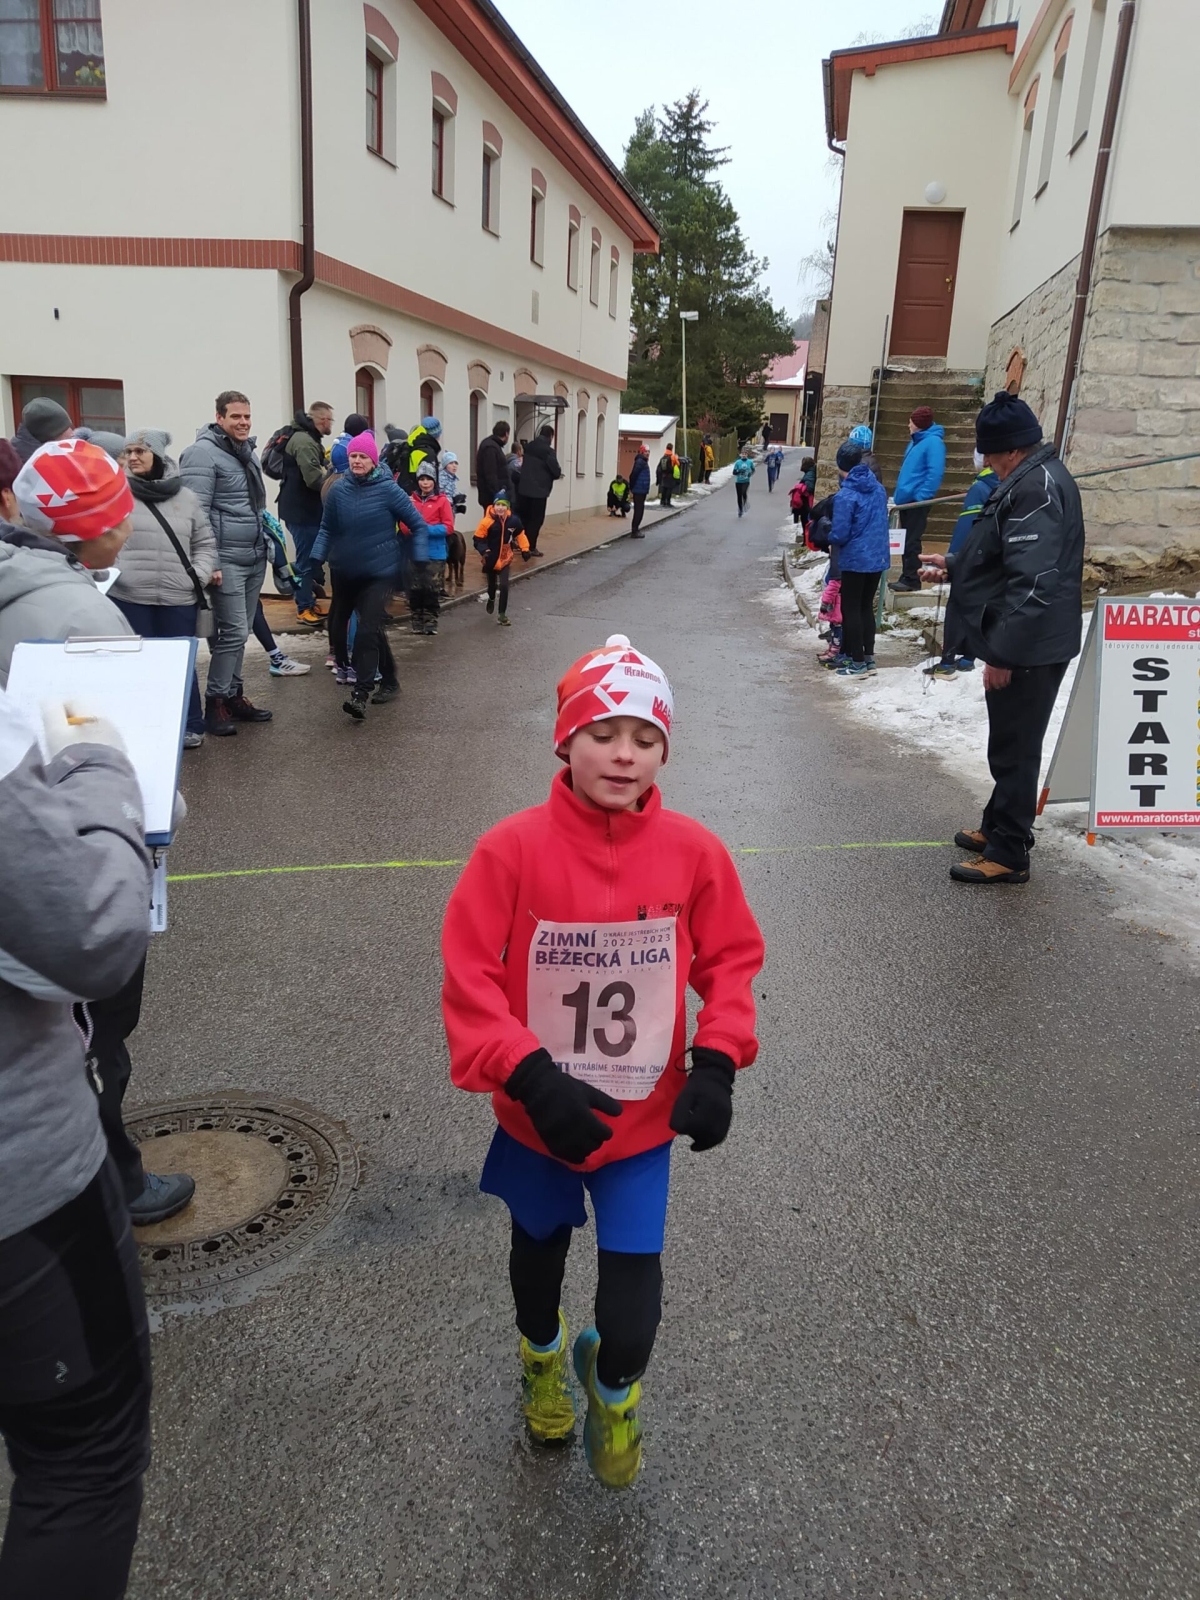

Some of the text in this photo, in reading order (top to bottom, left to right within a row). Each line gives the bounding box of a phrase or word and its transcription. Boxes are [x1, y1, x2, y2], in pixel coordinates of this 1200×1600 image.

[1163, 643, 1194, 651] jednota
[1127, 657, 1171, 808] START
[537, 930, 597, 948] ZIMNÍ
[535, 947, 671, 968] BĚŽECKÁ LIGA
[562, 981, 637, 1058] 13
[573, 1062, 608, 1072] VYRÁBÍME
[611, 1064, 647, 1074] STARTOVNÍ
